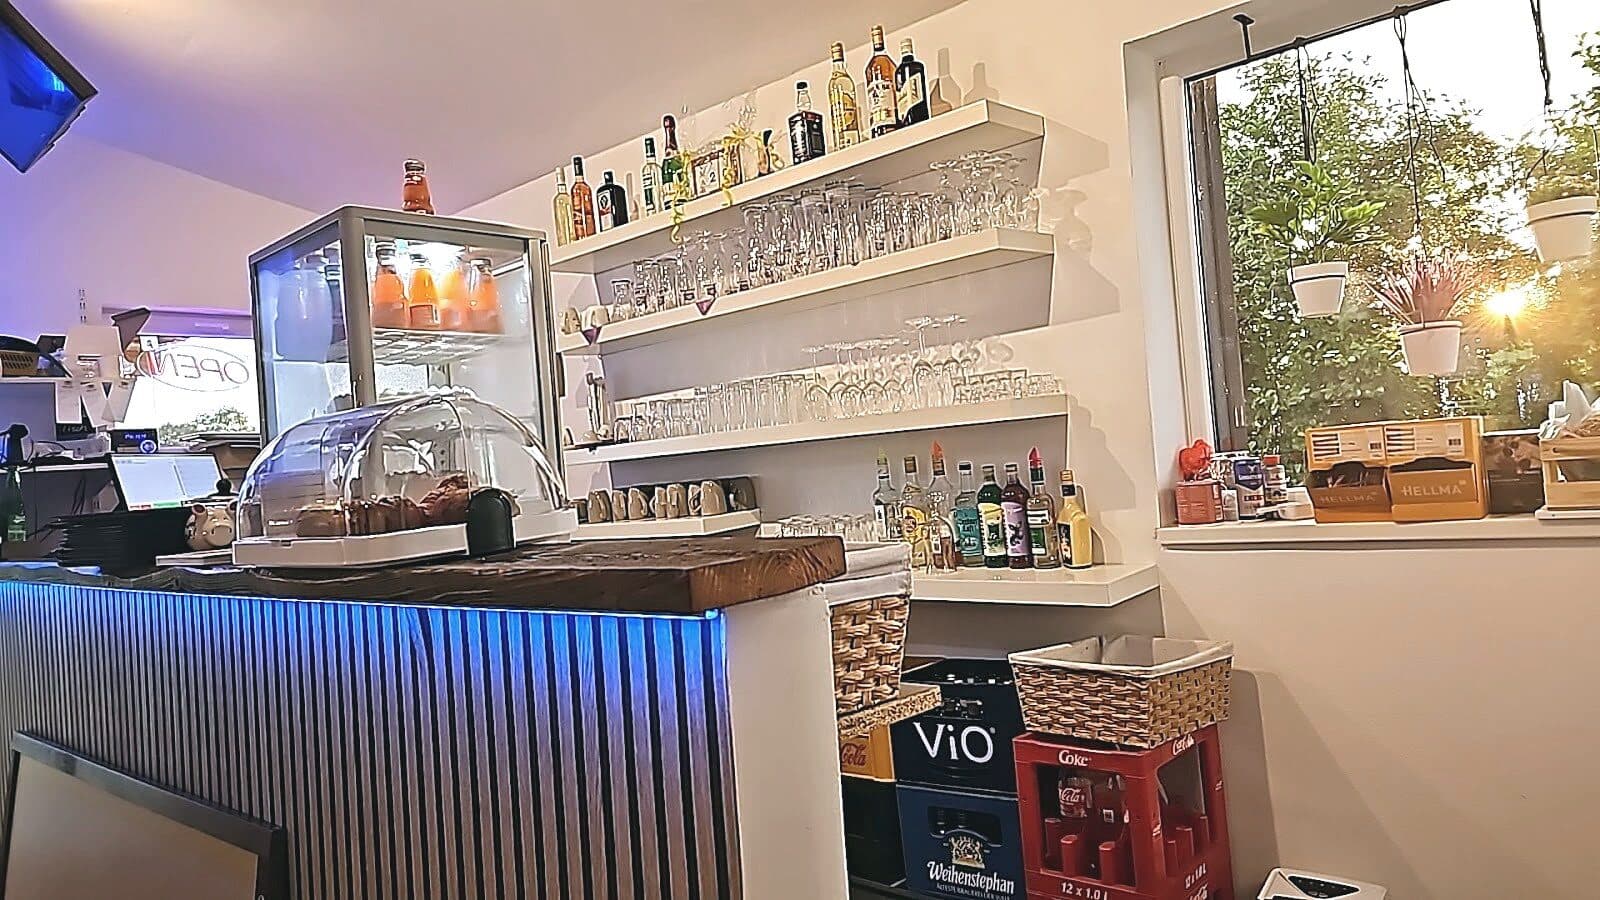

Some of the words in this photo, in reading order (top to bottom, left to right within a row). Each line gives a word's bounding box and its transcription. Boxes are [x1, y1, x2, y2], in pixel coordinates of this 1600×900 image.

[1320, 494, 1375, 503] HELLMA
[1401, 484, 1462, 497] HELLMA
[912, 721, 994, 763] ViO
[1058, 749, 1089, 767] Coke
[926, 860, 1015, 895] Weihenstephan
[1061, 881, 1074, 895] 12
[1075, 887, 1083, 897] x
[1085, 887, 1101, 900] 1.0
